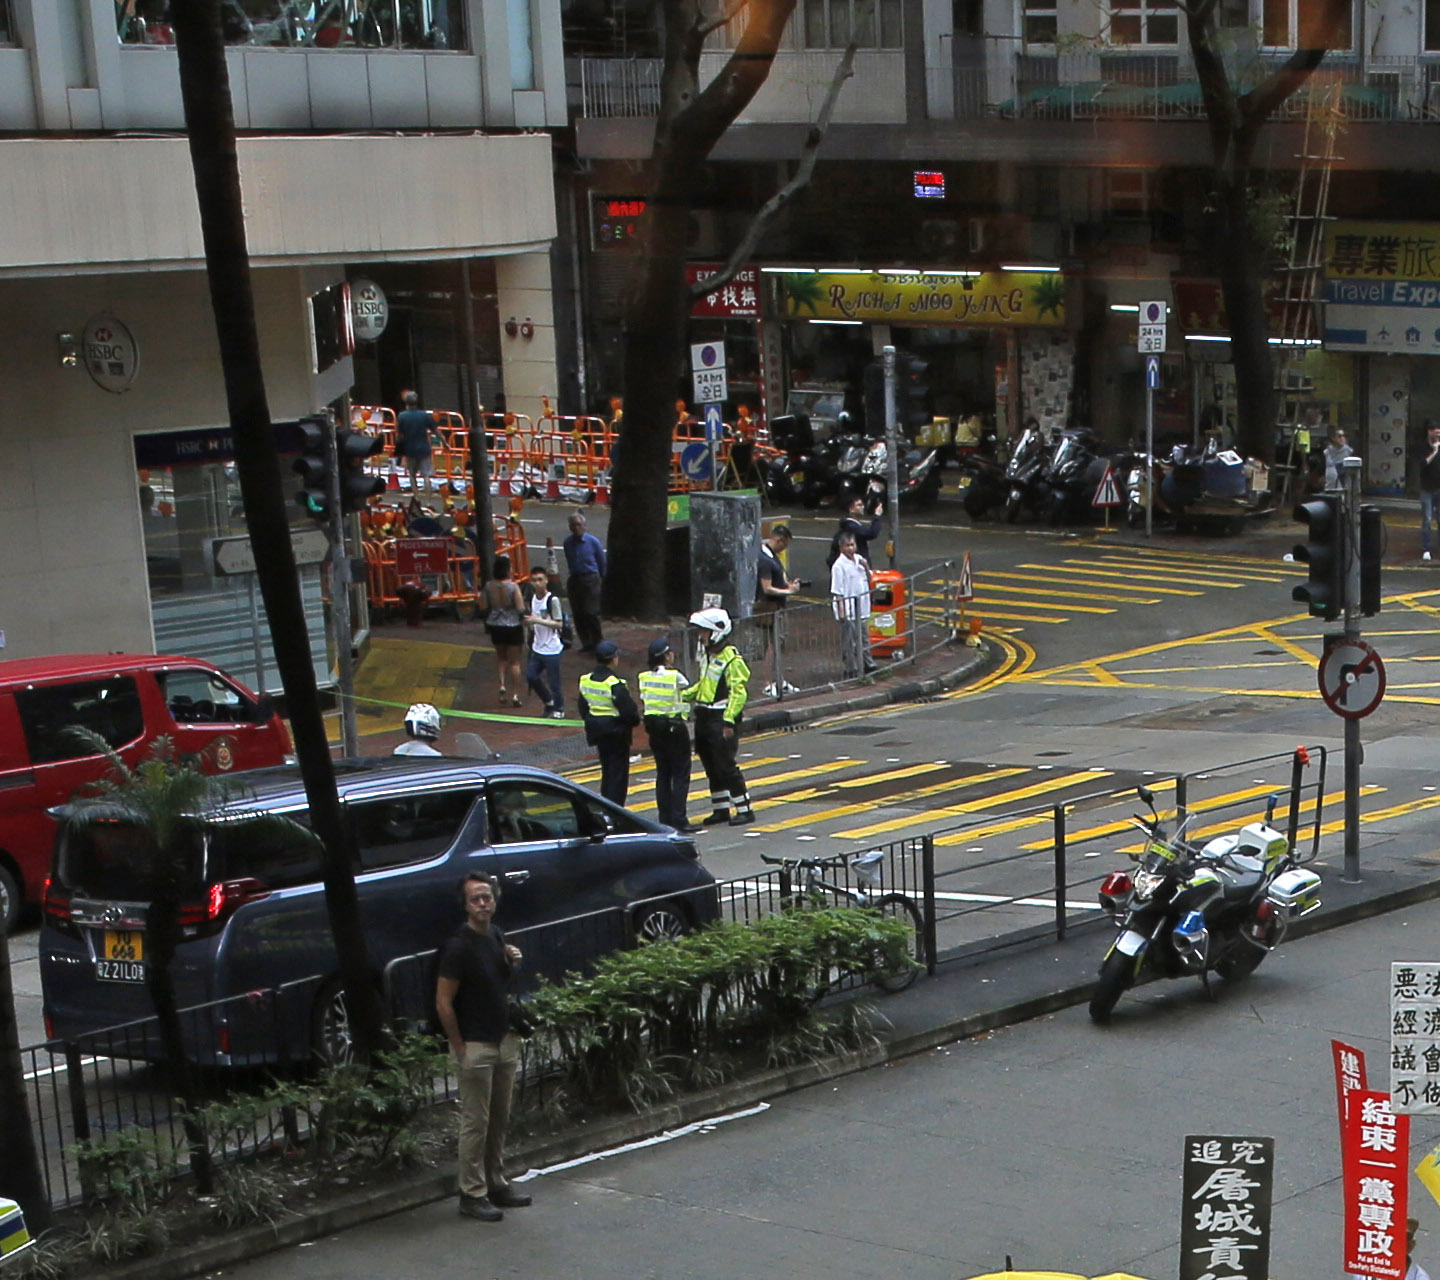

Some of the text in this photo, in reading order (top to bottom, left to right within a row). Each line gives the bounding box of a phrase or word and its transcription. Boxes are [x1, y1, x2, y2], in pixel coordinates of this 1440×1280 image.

[696, 270, 755, 282] EXCNGE
[1331, 281, 1386, 300] Travel
[354, 302, 384, 315] HSBC
[829, 284, 1023, 318] RACHA MOO YANG
[88, 344, 123, 361] HSBC
[697, 373, 723, 384] 24 hrs
[702, 385, 722, 400] 全日
[1192, 1141, 1264, 1166] 追究
[1358, 1098, 1397, 1258] 結束一黨專政
